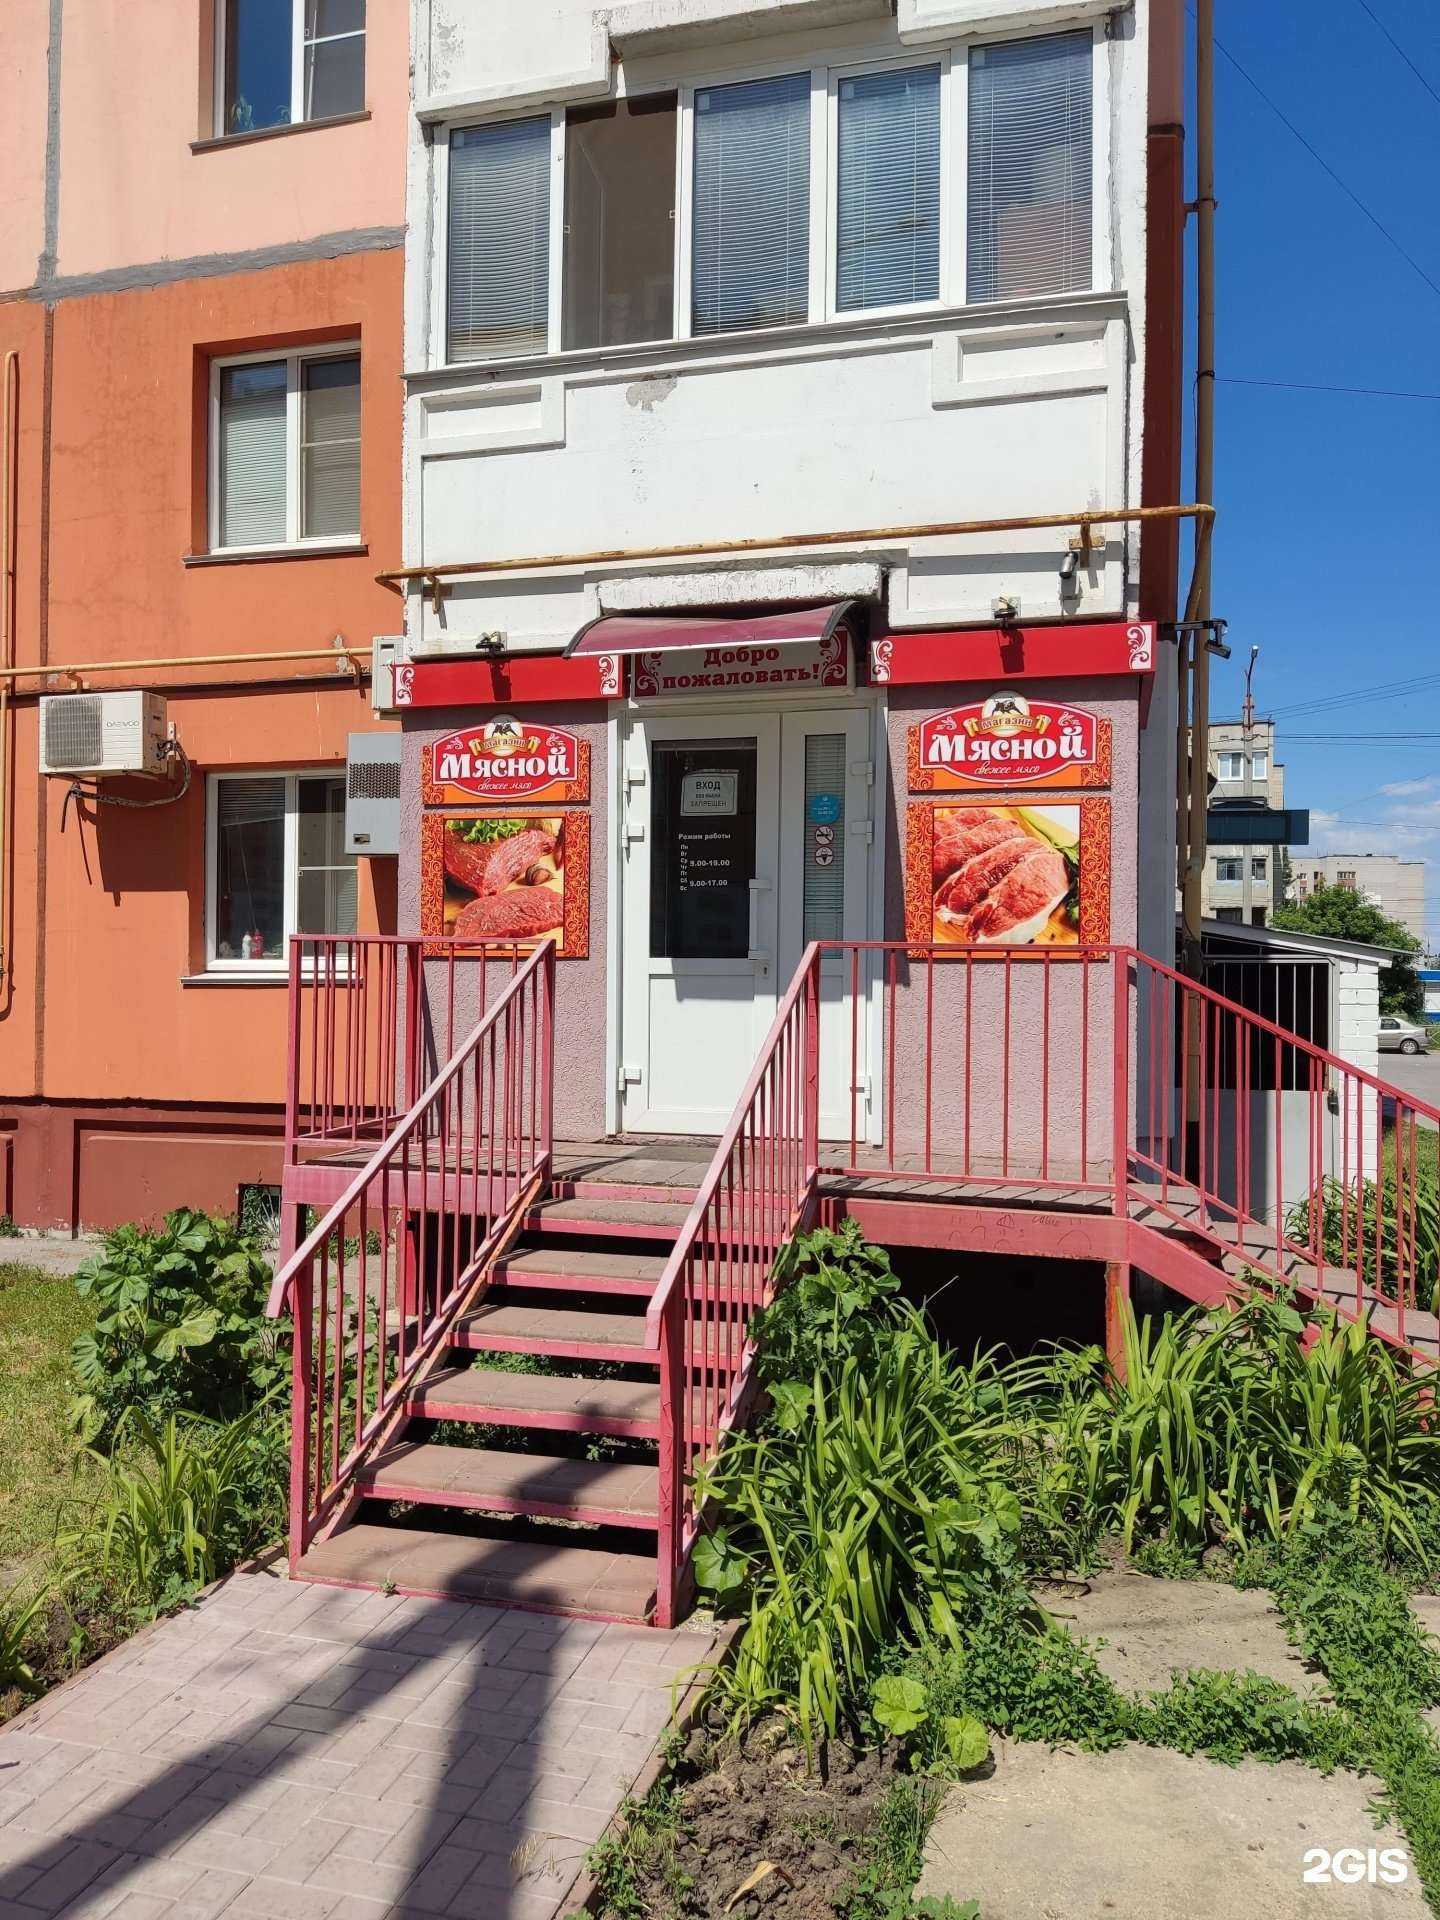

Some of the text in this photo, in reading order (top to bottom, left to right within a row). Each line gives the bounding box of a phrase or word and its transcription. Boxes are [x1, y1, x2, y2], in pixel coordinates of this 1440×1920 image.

[704, 646, 780, 668] Добро
[662, 664, 819, 689] пожаловать!
[928, 726, 1087, 763] Мясной
[439, 746, 569, 779] Мясной
[974, 761, 1040, 775] свежее мясо
[695, 780, 721, 791] ВХОД
[704, 832, 731, 841] работы
